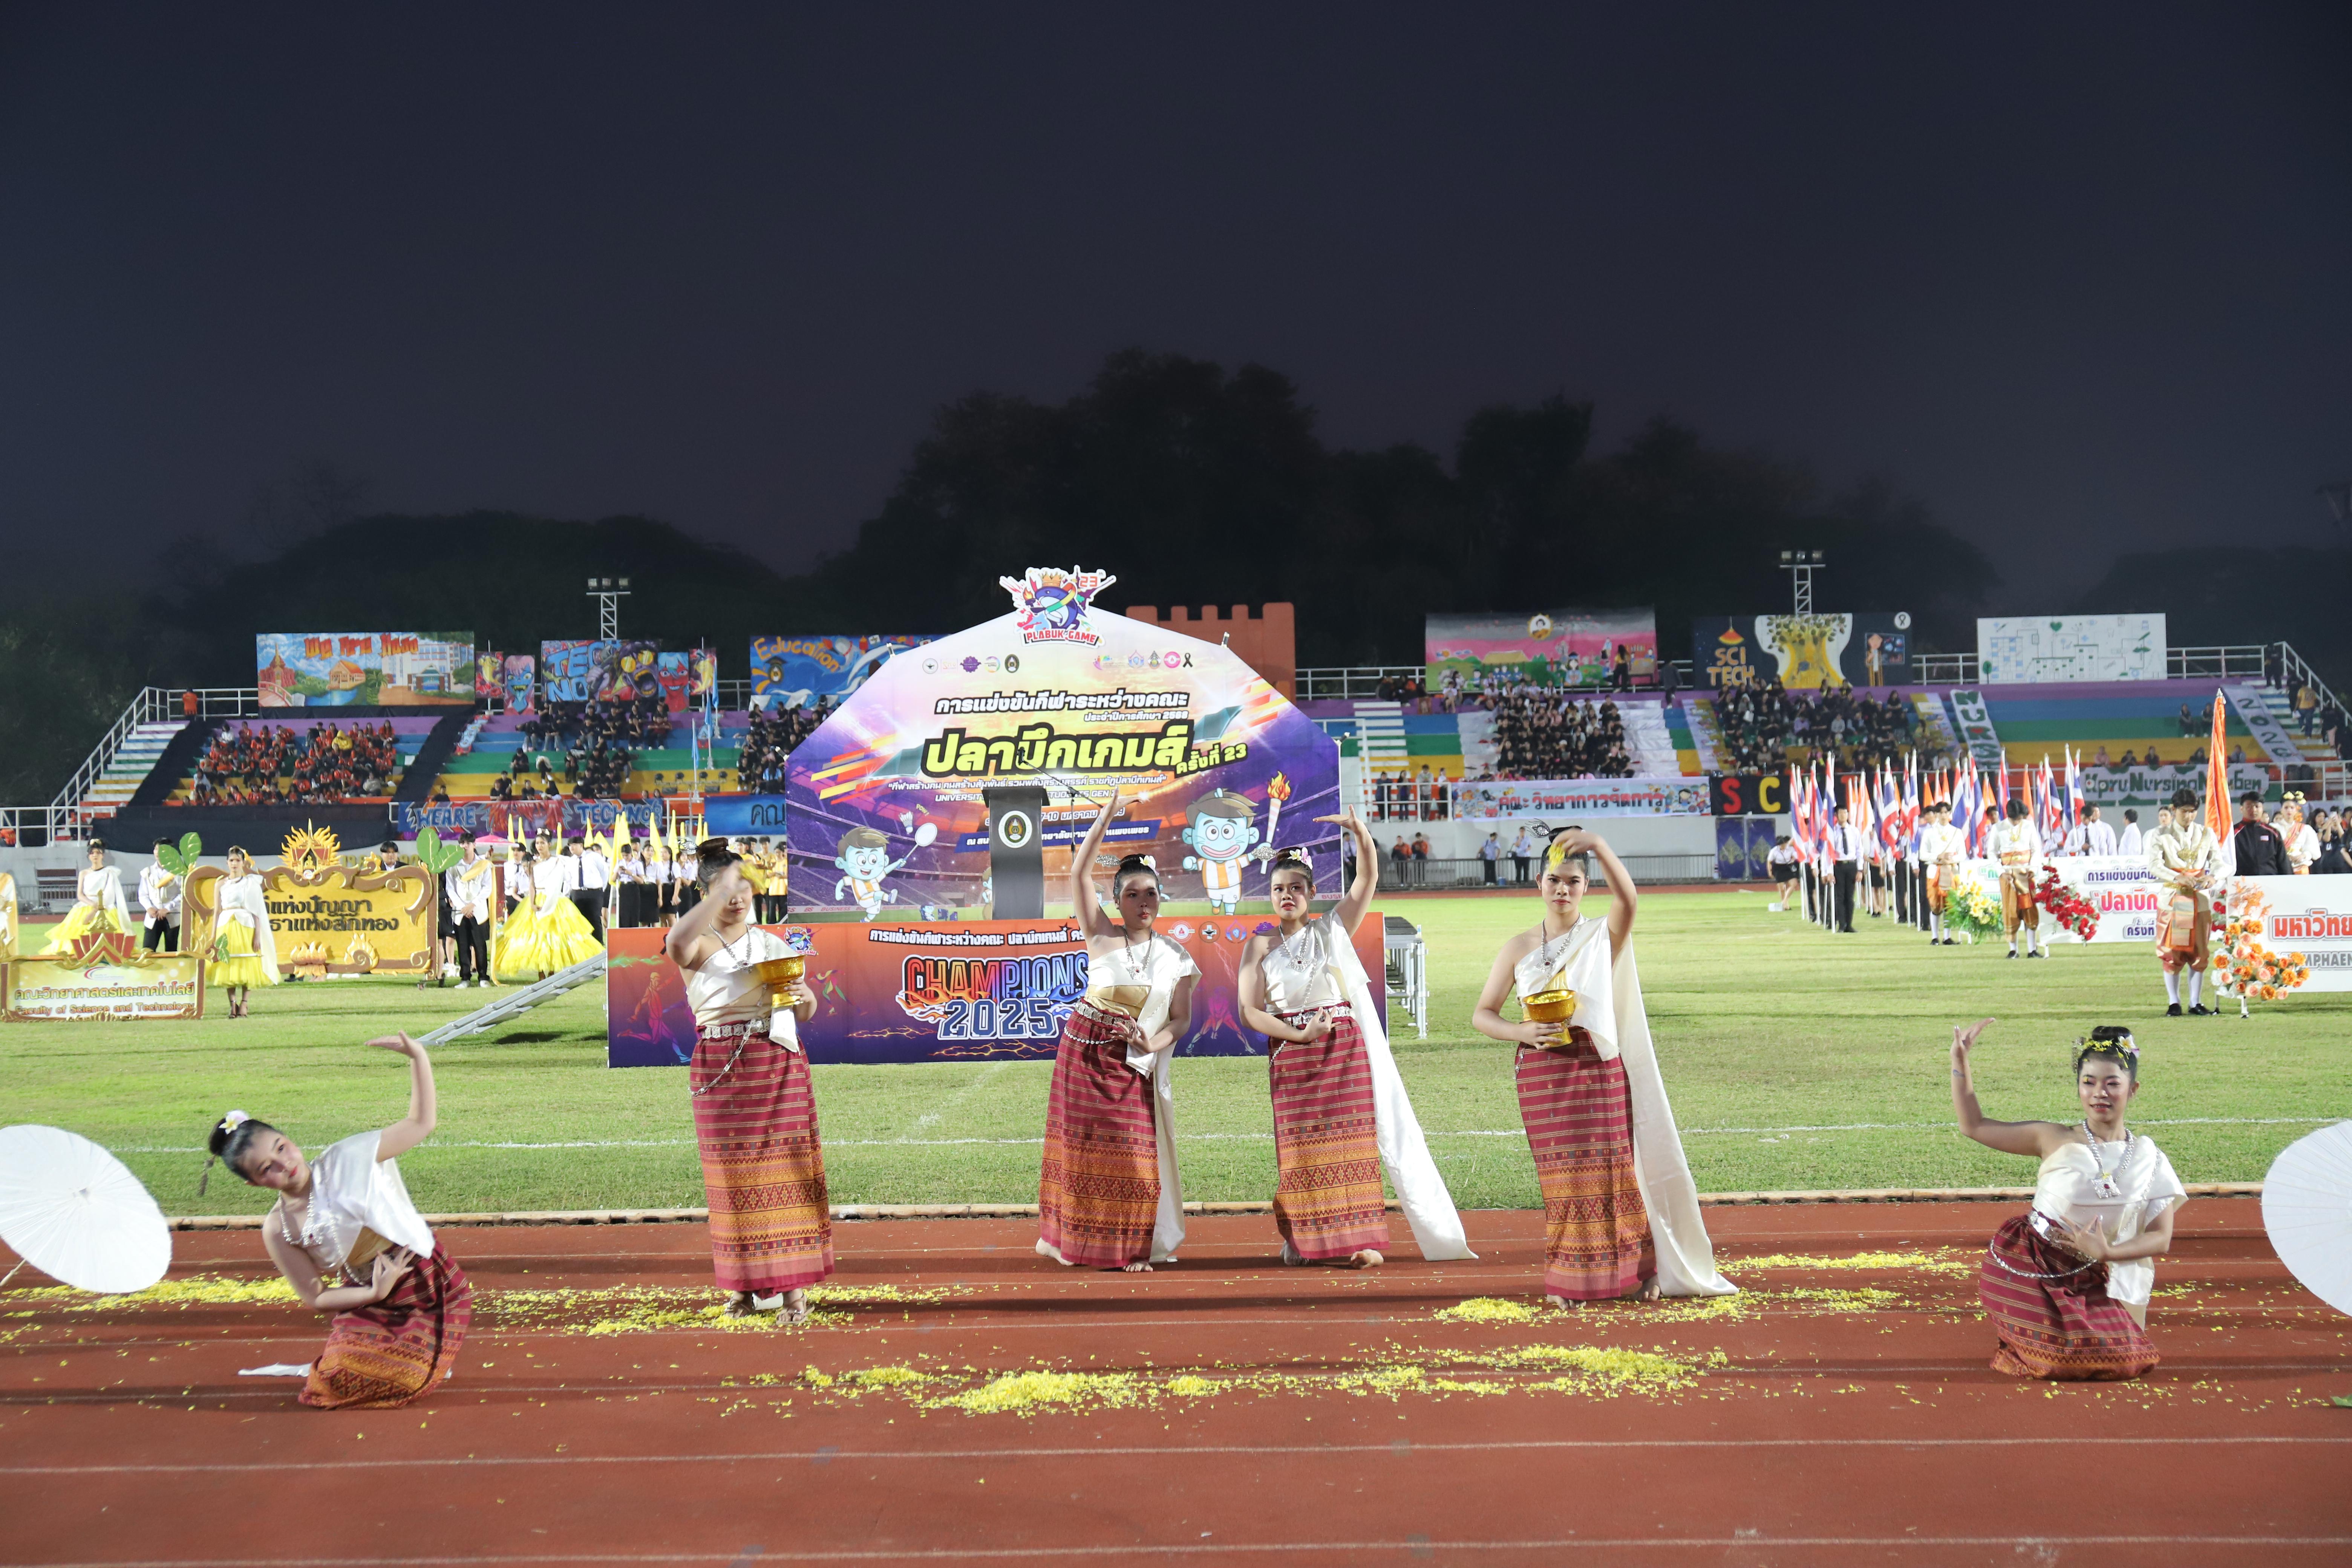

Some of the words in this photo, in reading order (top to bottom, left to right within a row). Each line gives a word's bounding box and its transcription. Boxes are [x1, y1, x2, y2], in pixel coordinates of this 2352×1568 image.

[1080, 576, 1098, 587] 23
[1026, 629, 1064, 641] PLABUK
[1068, 630, 1098, 643] GAME
[754, 636, 840, 673] Education
[1715, 646, 1746, 666] SCI
[1707, 665, 1755, 687] TECH
[545, 680, 588, 702] NO
[936, 690, 1188, 714] การแข่งขันกีฬาระหว่างคณะ
[1084, 712, 1161, 722] ประจำปีการศึกษา
[1163, 711, 1188, 719] 2568
[926, 724, 1188, 772] ปลาบึกเกมส์
[1176, 744, 1220, 774] ครั้งที่
[1225, 744, 1247, 761] 23
[916, 804, 930, 816] POW!
[1061, 809, 1098, 821] มกราคม
[870, 929, 1004, 945] การแข่งขันกีฬาระหว่างคณะ
[906, 954, 1089, 1003] CHAMPIONS
[14, 982, 195, 1000] คณะวิทยาศาสตร์และเทคโนโลยี
[15, 1005, 52, 1016] Faculty
[56, 1004, 66, 1014] of
[69, 1003, 110, 1014] Science
[114, 1002, 133, 1013] and
[942, 998, 1057, 1038] 2025
